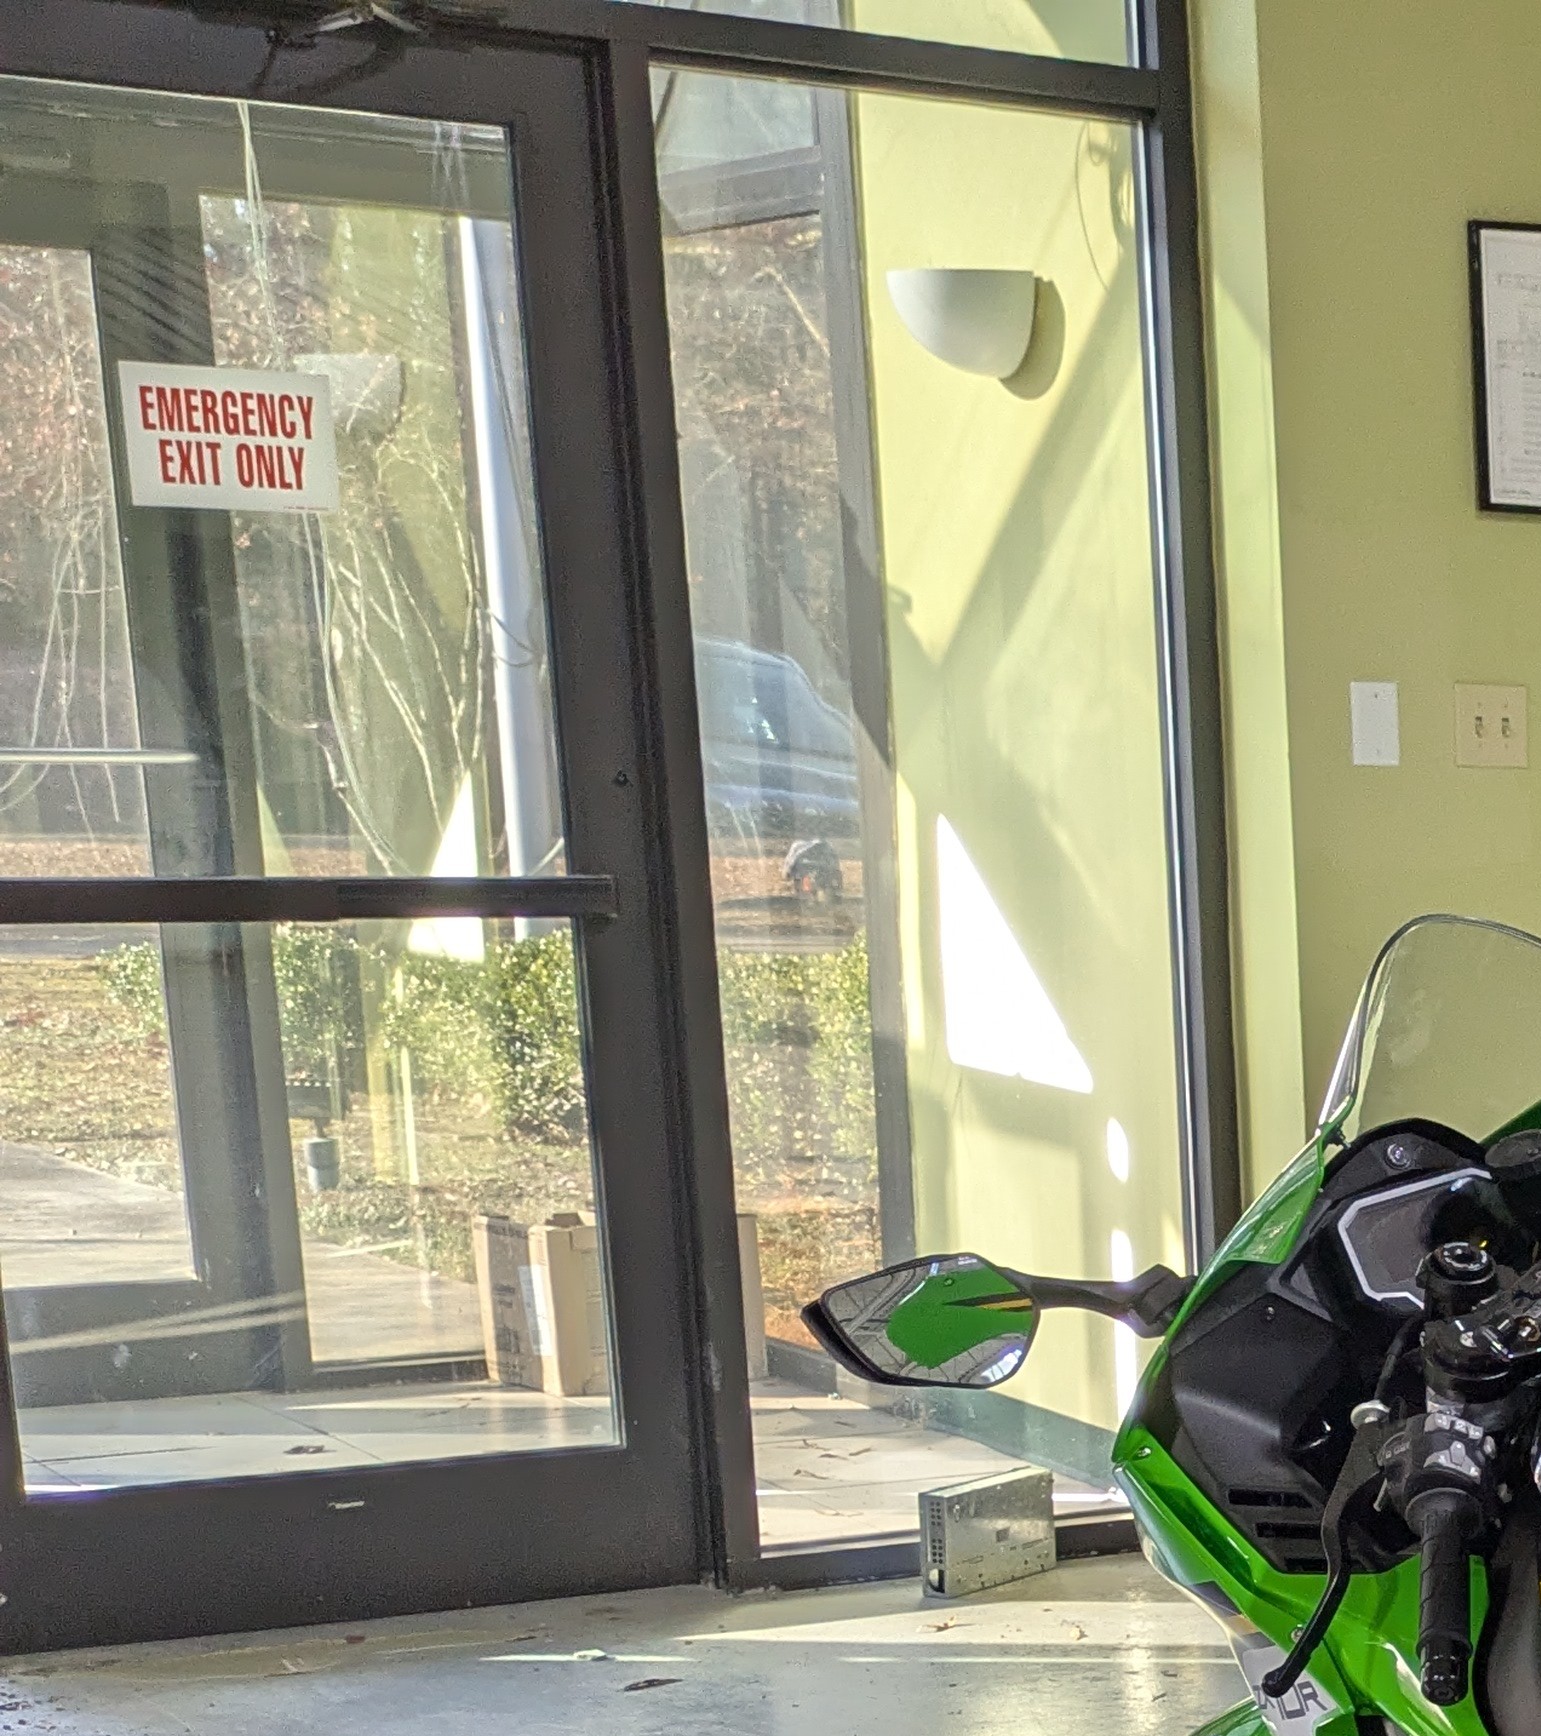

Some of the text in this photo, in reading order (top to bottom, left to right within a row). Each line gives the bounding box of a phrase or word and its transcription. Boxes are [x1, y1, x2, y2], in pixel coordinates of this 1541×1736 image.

[138, 385, 313, 440] EMERGENCY
[158, 439, 305, 490] EXIT ONLY
